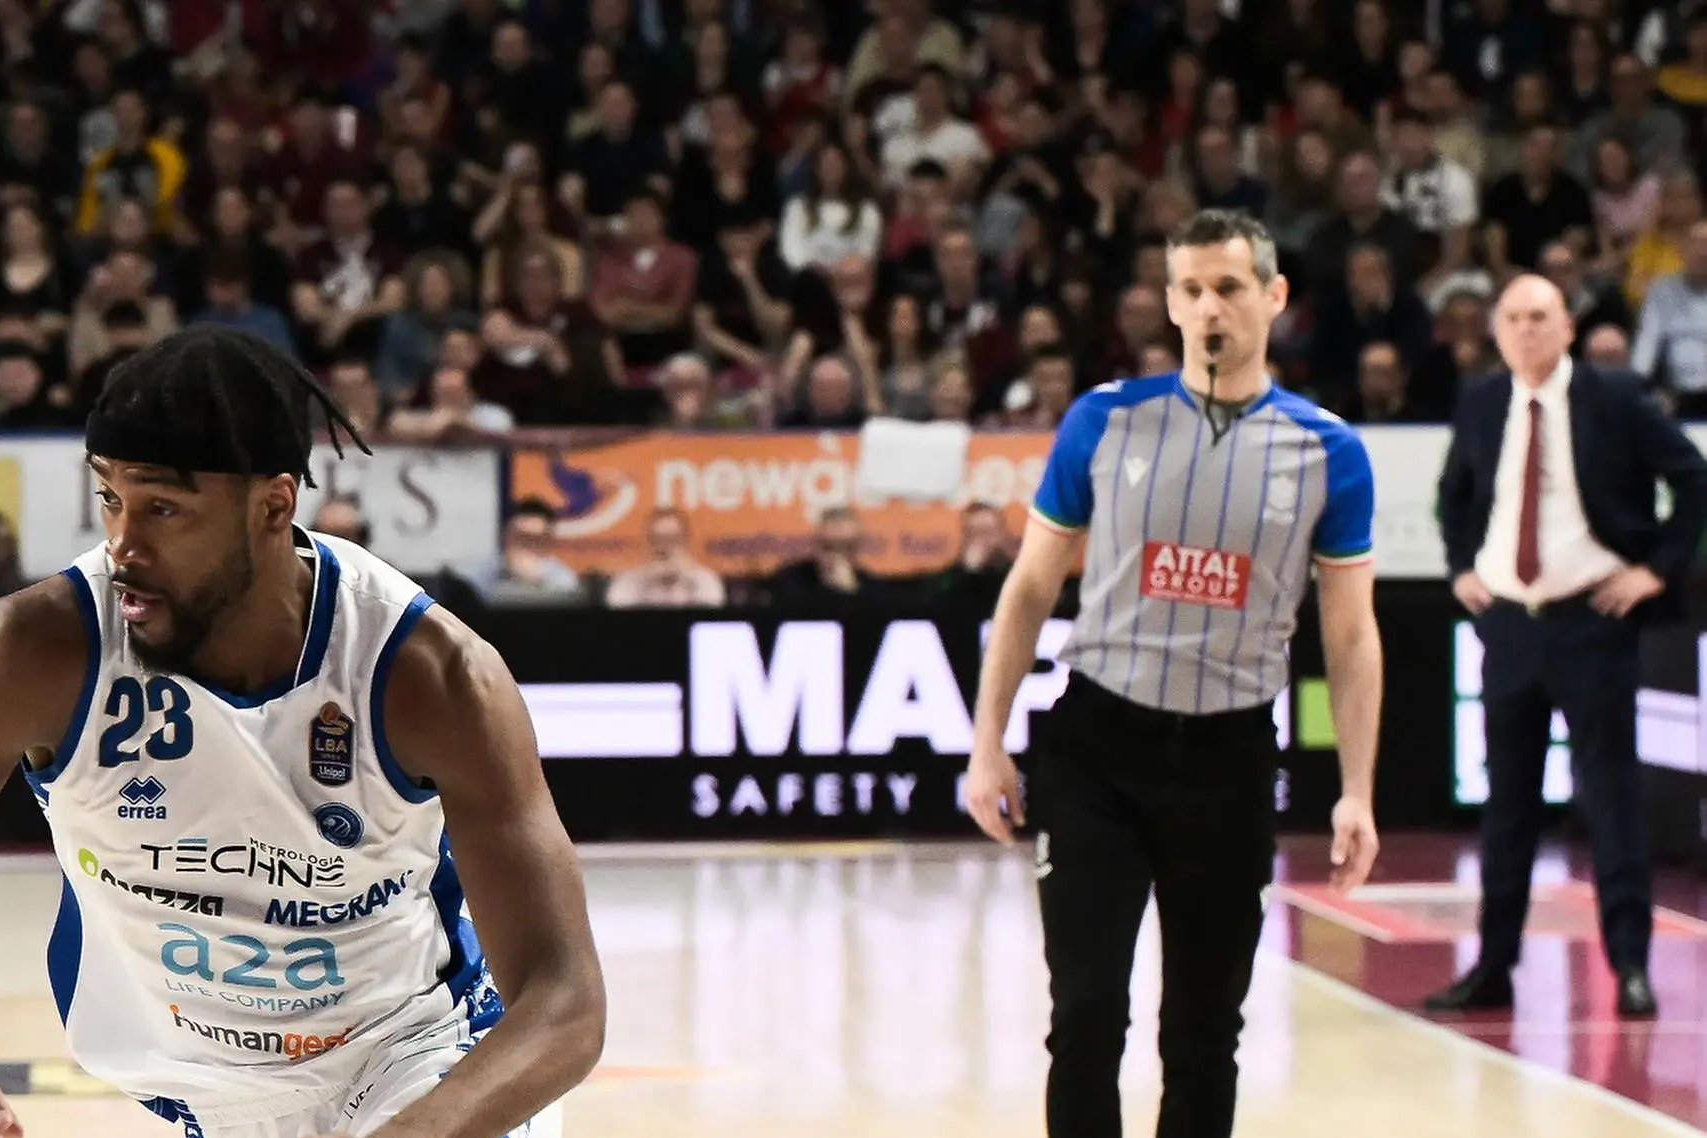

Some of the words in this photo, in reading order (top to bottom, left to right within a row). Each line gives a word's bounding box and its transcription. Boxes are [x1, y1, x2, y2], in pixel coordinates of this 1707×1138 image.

[1153, 545, 1240, 580] ATTAL
[1150, 569, 1240, 597] GROUP
[98, 675, 194, 768] 23
[315, 738, 348, 753] LBA
[117, 802, 167, 820] errea
[691, 772, 919, 818] SAFETY
[140, 837, 346, 889] TECHNE
[250, 837, 345, 869] METROLOGIA
[264, 869, 414, 928] MEGRAN
[156, 922, 345, 991] a2a
[165, 978, 213, 998] LIFE
[220, 990, 350, 1012] COMPANY
